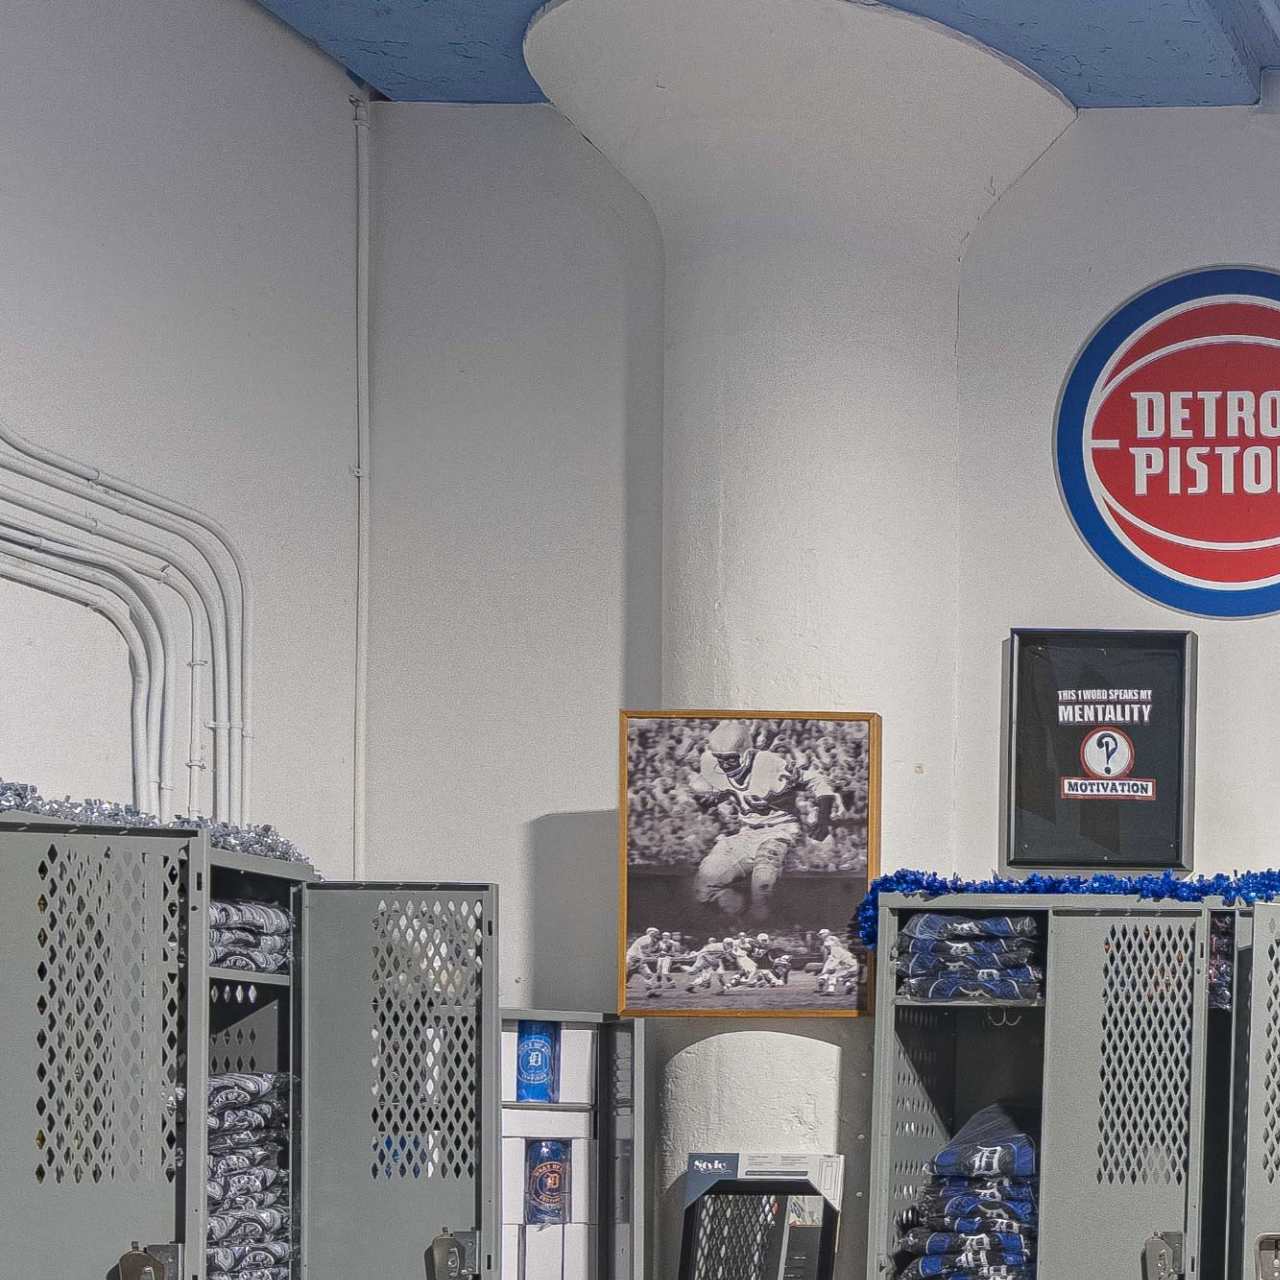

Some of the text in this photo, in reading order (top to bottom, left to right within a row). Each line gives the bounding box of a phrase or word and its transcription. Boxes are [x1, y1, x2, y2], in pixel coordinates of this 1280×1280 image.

[1057, 689, 1076, 701] THIS
[1083, 689, 1107, 701] WORD
[1109, 688, 1139, 701] SPEAKS
[1140, 689, 1153, 701] MY
[1058, 704, 1152, 722] MENTALITY
[1067, 781, 1149, 795] MOTIVATION
